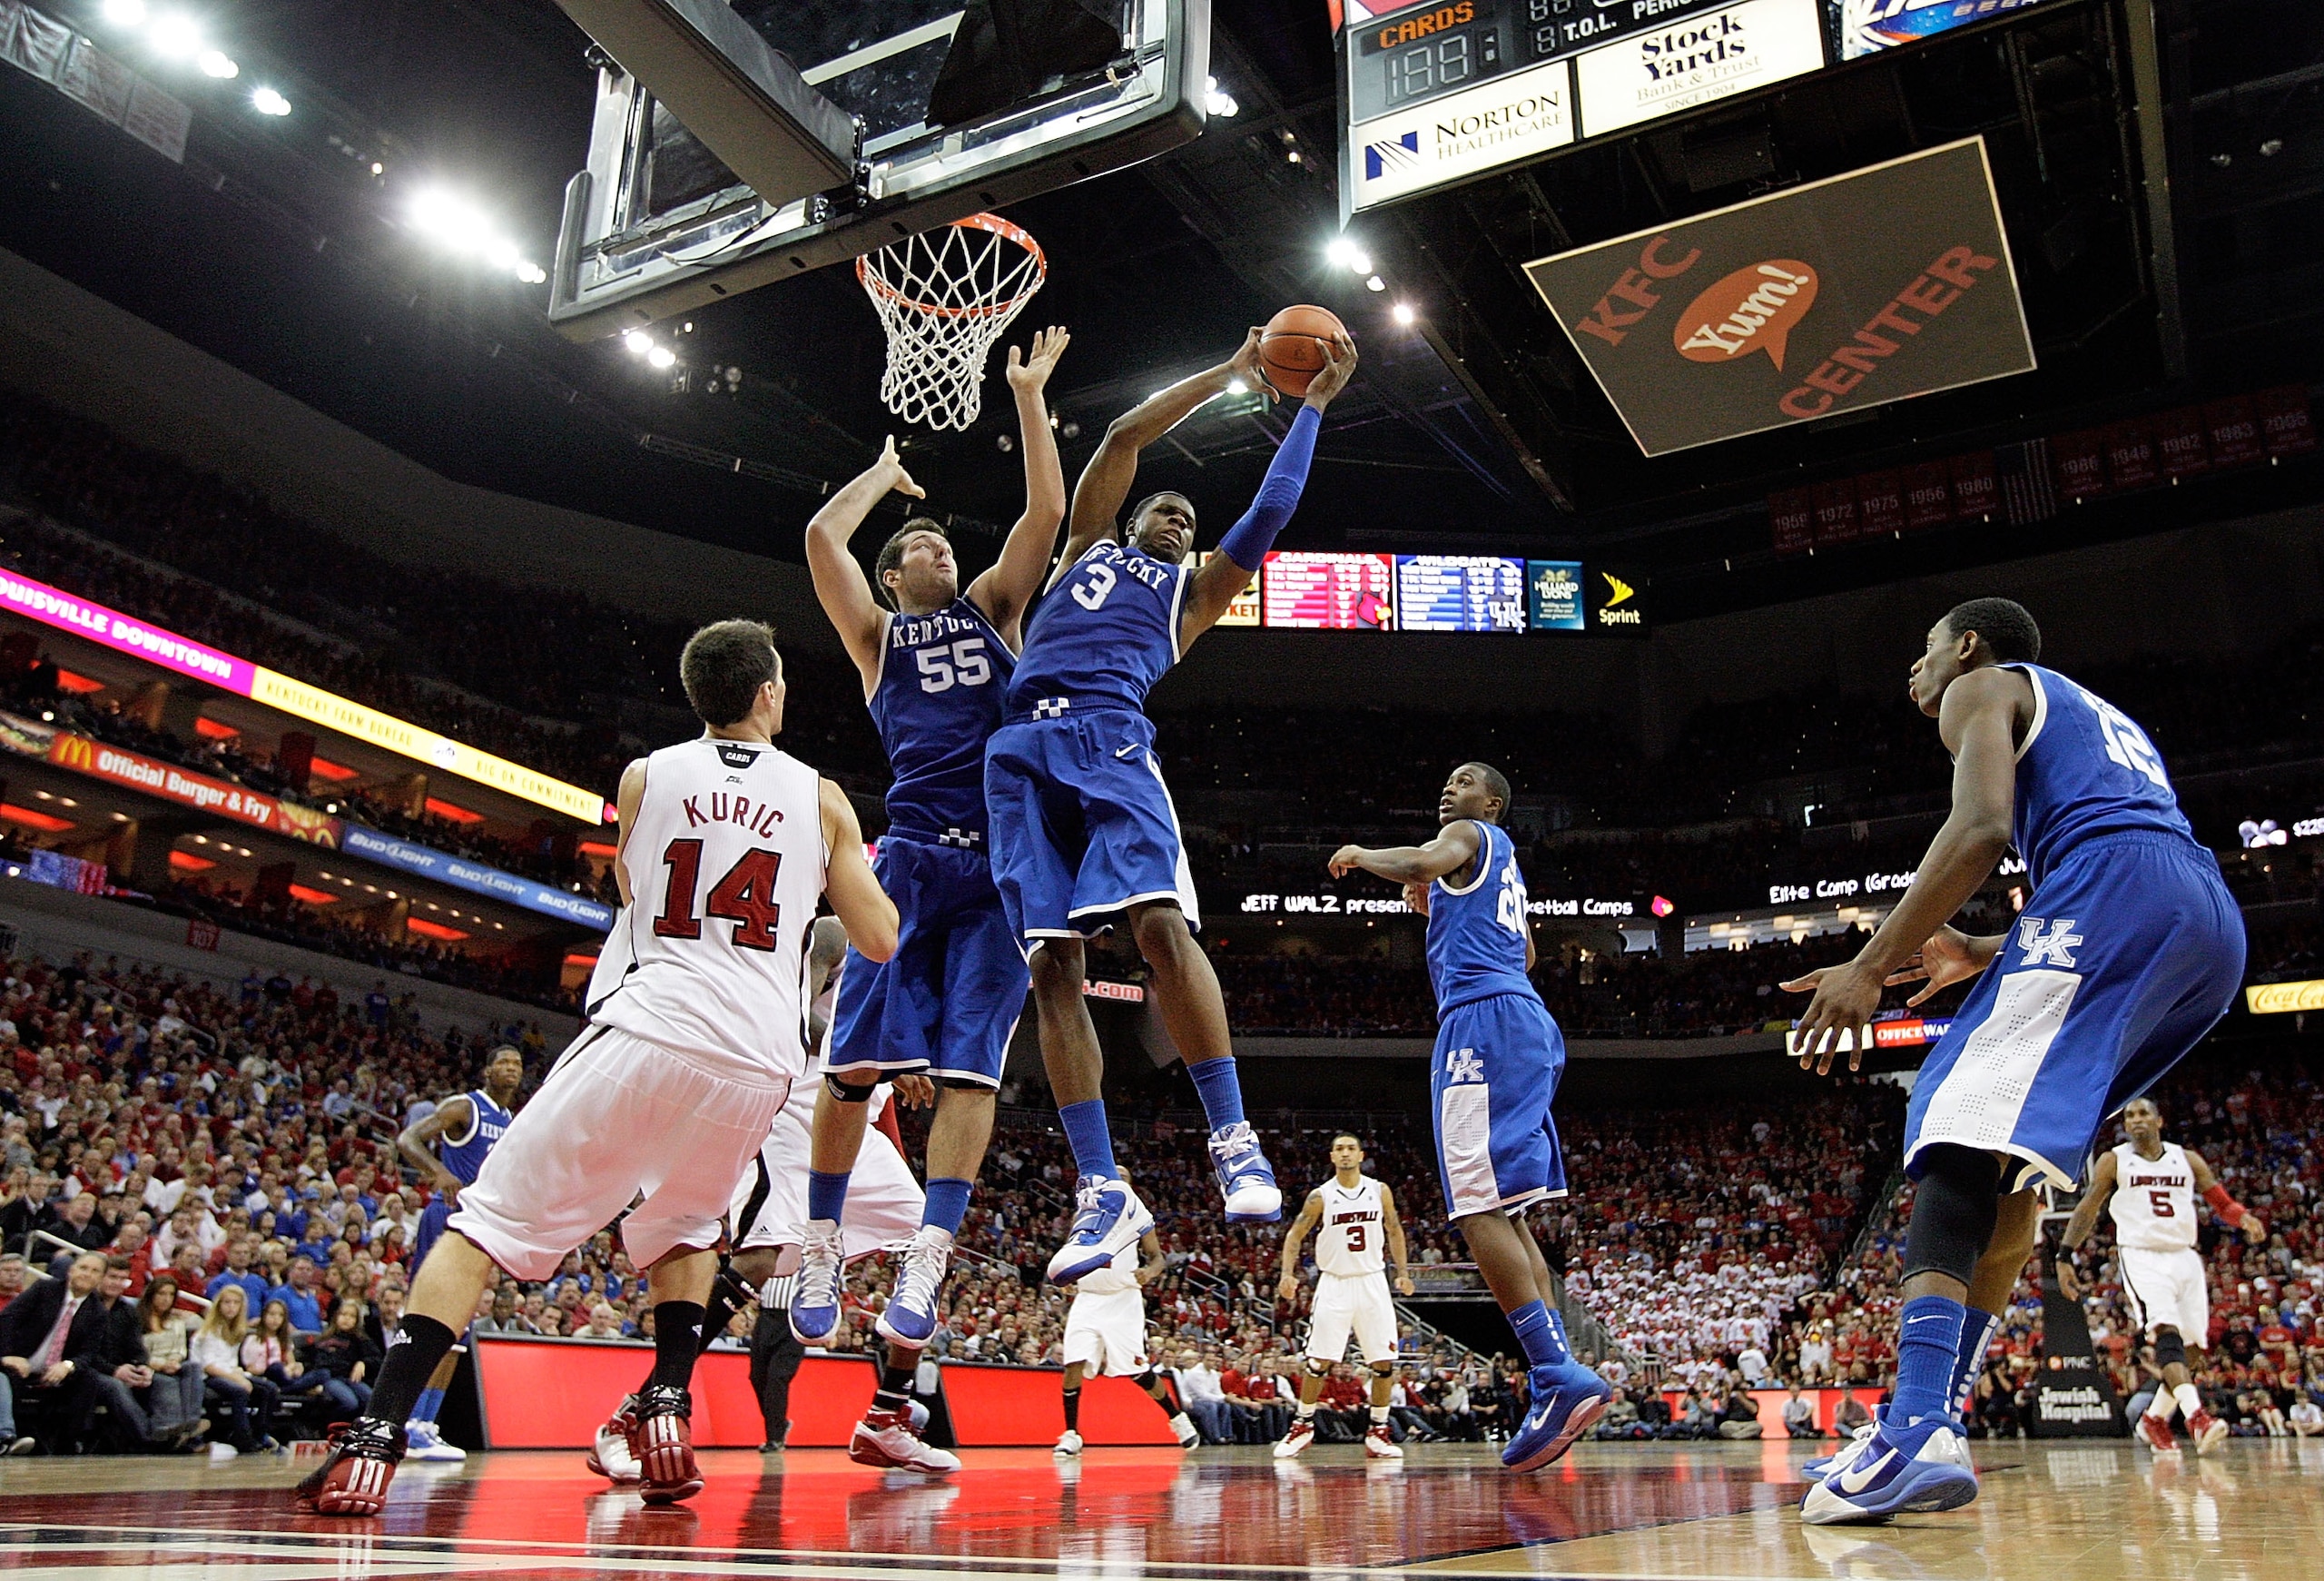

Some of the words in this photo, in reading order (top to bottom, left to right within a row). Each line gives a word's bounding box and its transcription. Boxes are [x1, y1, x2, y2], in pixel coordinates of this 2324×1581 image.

[1379, 1, 1475, 48] CARDS
[1562, 14, 1618, 42] T.O.L.
[1641, 15, 1744, 62] Stock
[1637, 76, 1685, 102] Bank
[1689, 71, 1702, 84] &
[1709, 55, 1761, 80] Trust
[1644, 39, 1746, 82] Yards
[1436, 91, 1561, 143] NORTON
[1664, 94, 1703, 112] SINCE
[1438, 113, 1563, 160] HEALTHCARE
[1576, 236, 1702, 347] KFC
[1681, 264, 1809, 355] Yum!
[1778, 245, 1999, 420] CENTER
[1278, 552, 1377, 564] CARDINALS
[1416, 556, 1502, 568] WILDCATS
[1070, 563, 1118, 610] 3
[1534, 581, 1579, 592] HILLIARD
[1600, 608, 1641, 626] Sprint
[112, 620, 232, 679] DOWNTOWN
[915, 637, 991, 694] 55
[266, 682, 329, 715] KENTUCKY
[725, 751, 751, 764] CARDS
[97, 749, 165, 787] Official
[167, 772, 227, 808] Burger
[228, 791, 242, 810] &
[244, 797, 271, 824] Fry
[683, 791, 784, 840] KURIC
[654, 837, 783, 953] 14
[1241, 894, 1279, 912] JEFF
[1285, 895, 1341, 913] WALZ
[1583, 898, 1634, 917] Camps
[1770, 884, 1809, 904] Elite
[1816, 877, 1859, 897] Camp
[2017, 916, 2084, 968] UK
[1446, 1048, 1484, 1083] UK
[2149, 1191, 2175, 1218] 5
[1346, 1225, 1366, 1252] 3
